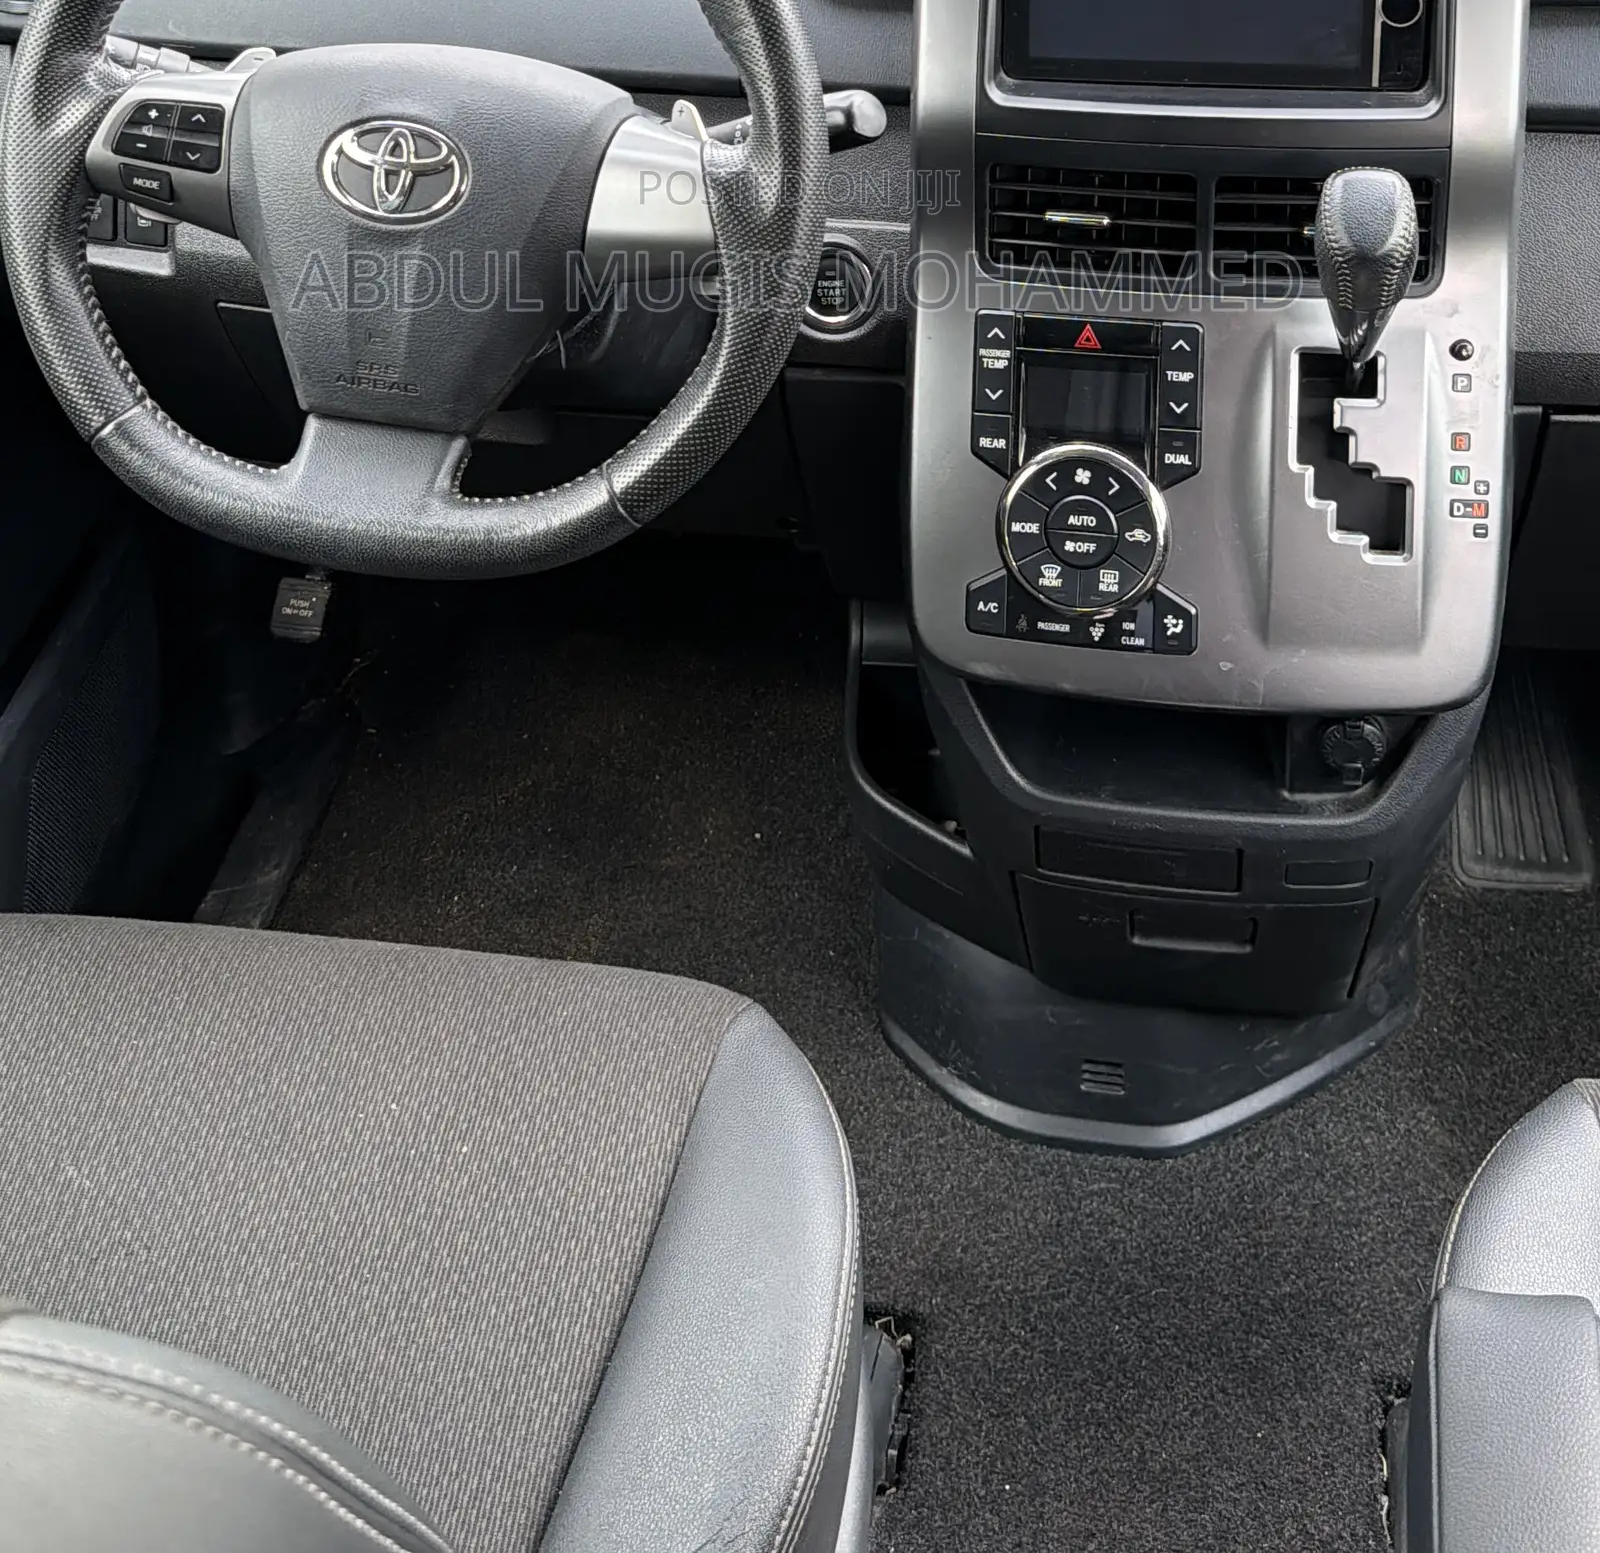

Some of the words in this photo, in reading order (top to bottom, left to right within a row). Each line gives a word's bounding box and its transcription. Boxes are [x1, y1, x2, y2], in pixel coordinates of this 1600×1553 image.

[133, 176, 161, 190] MODE
[817, 280, 845, 288] ENGINE
[816, 288, 848, 297] START
[820, 297, 845, 305] STOP
[979, 348, 1011, 358] PASSENGER
[982, 358, 1009, 370] TEMP
[1166, 370, 1194, 383] TEMP
[335, 373, 420, 395] AIRBAG
[1456, 377, 1468, 391] P
[979, 436, 1006, 449] REAR
[1455, 436, 1466, 449] R
[1164, 452, 1192, 465] DUAL
[1454, 469, 1466, 483] N
[1067, 514, 1097, 527] AUTO
[1011, 521, 1040, 534] MODE
[1076, 541, 1097, 554] OFF
[1038, 578, 1063, 588] FRONT
[1098, 582, 1119, 593] REAR
[289, 598, 310, 608] PUSH
[977, 600, 999, 614] A/C
[281, 607, 293, 615] ON
[1037, 621, 1071, 633] PASSENGER
[1122, 621, 1136, 631] ION
[1120, 634, 1145, 646] CLEAN
